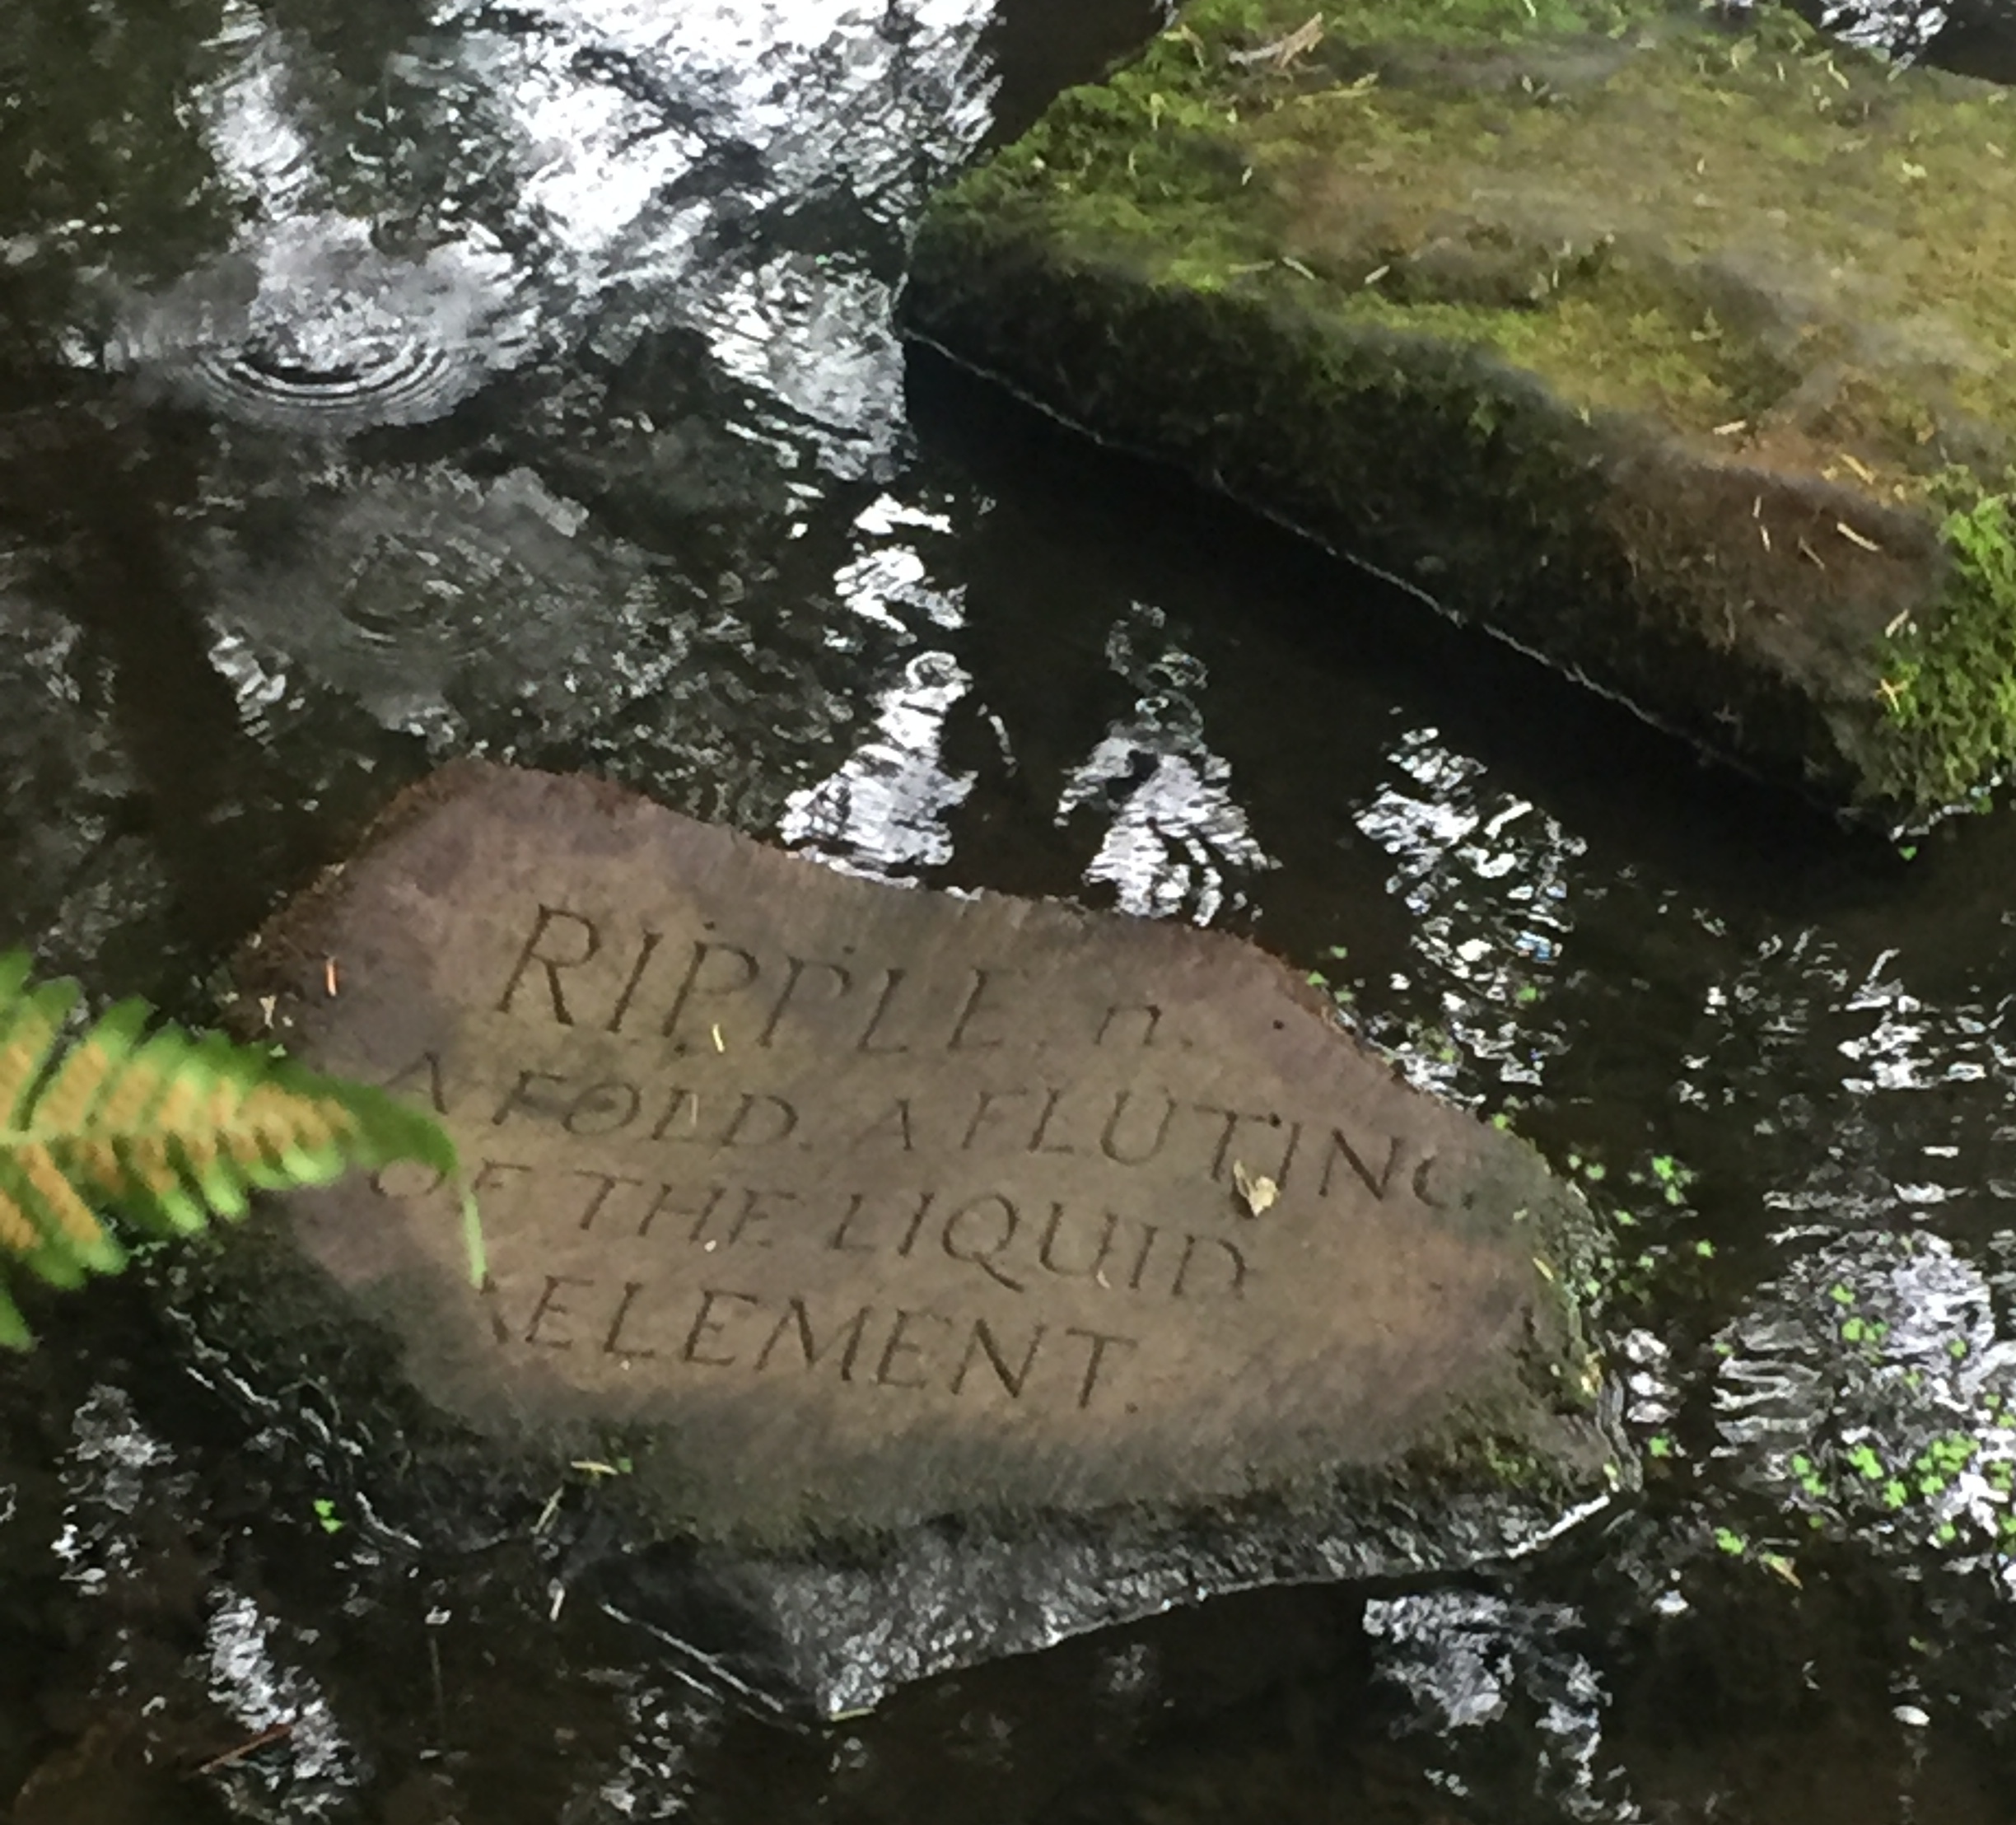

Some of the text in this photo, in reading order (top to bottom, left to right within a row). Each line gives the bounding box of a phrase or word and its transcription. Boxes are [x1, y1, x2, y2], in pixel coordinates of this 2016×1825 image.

[379, 1050, 450, 1115] A
[848, 1096, 913, 1152] A
[567, 1166, 800, 1249] THE
[824, 1190, 1250, 1301] LIQUID
